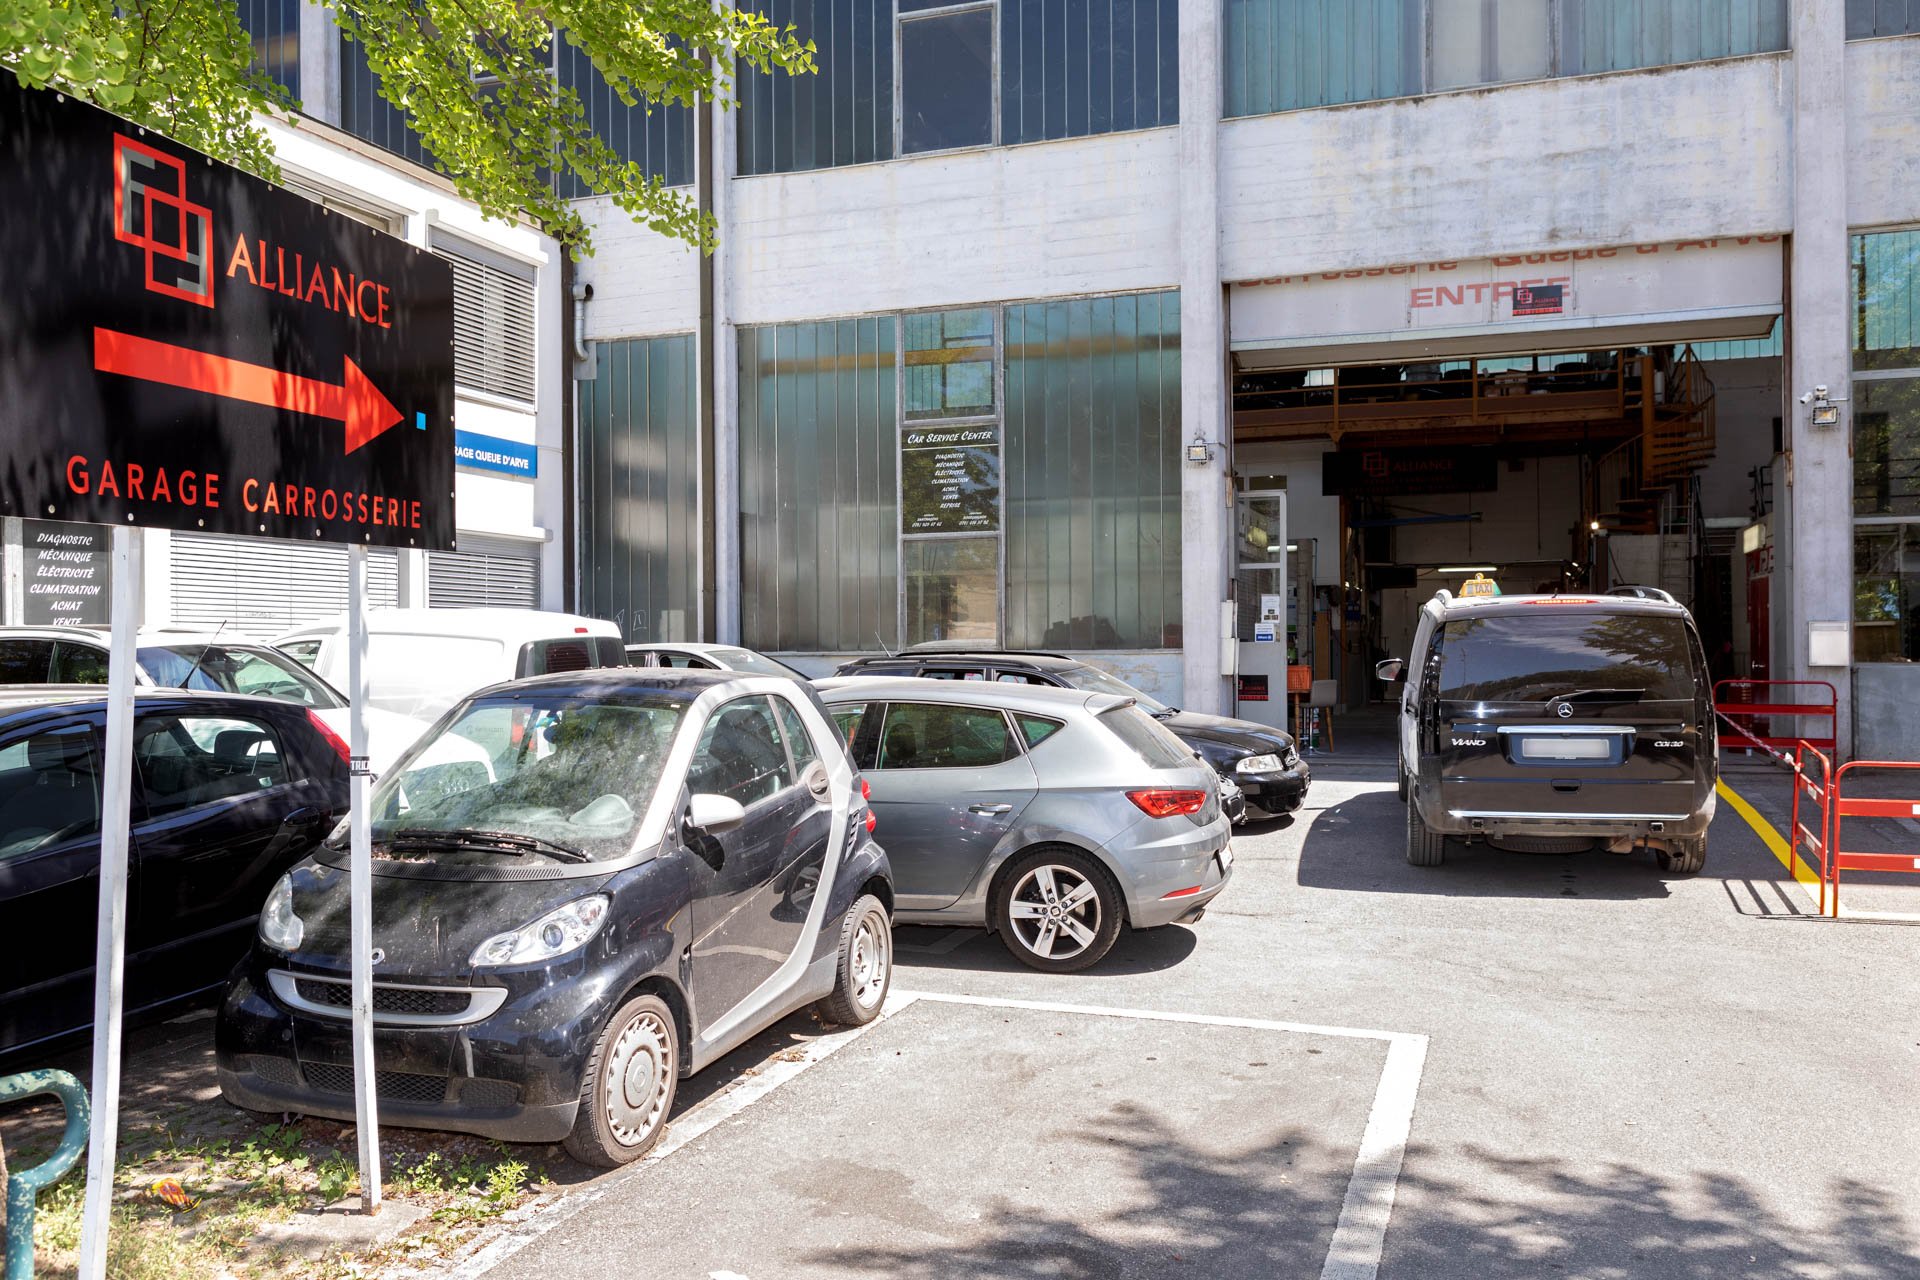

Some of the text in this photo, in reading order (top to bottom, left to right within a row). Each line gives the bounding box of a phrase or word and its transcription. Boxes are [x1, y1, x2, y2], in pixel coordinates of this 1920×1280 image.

[226, 232, 392, 329] ALLIANCE
[907, 431, 992, 444] CAR SERVICE CENTER
[475, 449, 501, 464] QUEUE
[502, 454, 529, 469] D'ARVE
[66, 455, 421, 529] GARAGE CARROSSERIE
[37, 533, 93, 546] DIAGNOSTIC
[38, 549, 93, 563] MÉCANIQUE
[30, 584, 100, 595] CLIMATISATION
[1475, 584, 1492, 594] TAXI
[50, 601, 83, 611] ACHAT
[1452, 738, 1487, 746] VIANO
